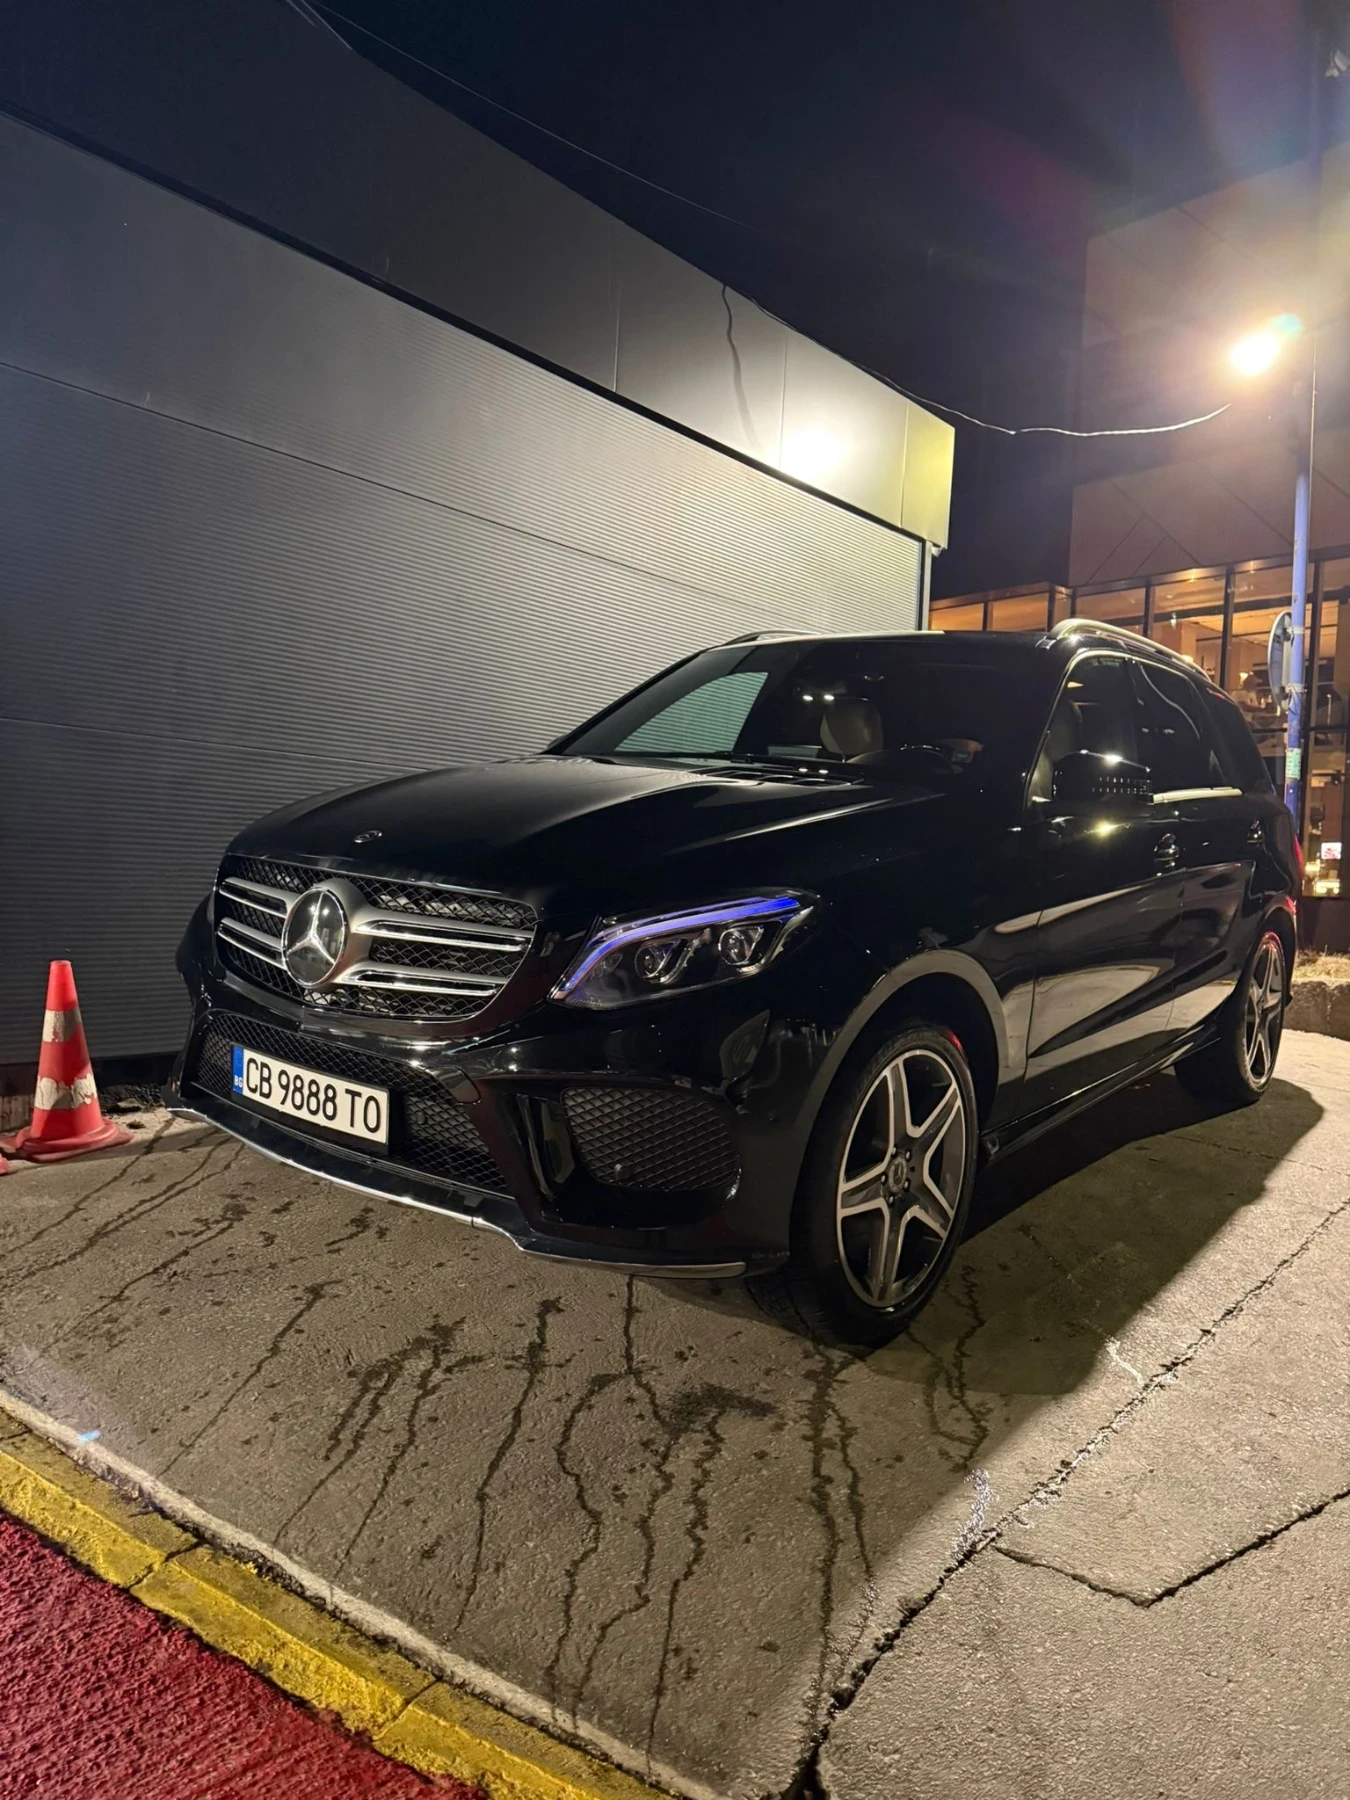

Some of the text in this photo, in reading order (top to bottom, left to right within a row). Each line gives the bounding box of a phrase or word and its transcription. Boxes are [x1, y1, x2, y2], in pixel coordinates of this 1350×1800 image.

[234, 1074, 243, 1088] BG
[246, 1058, 381, 1133] CB 9888 TO
